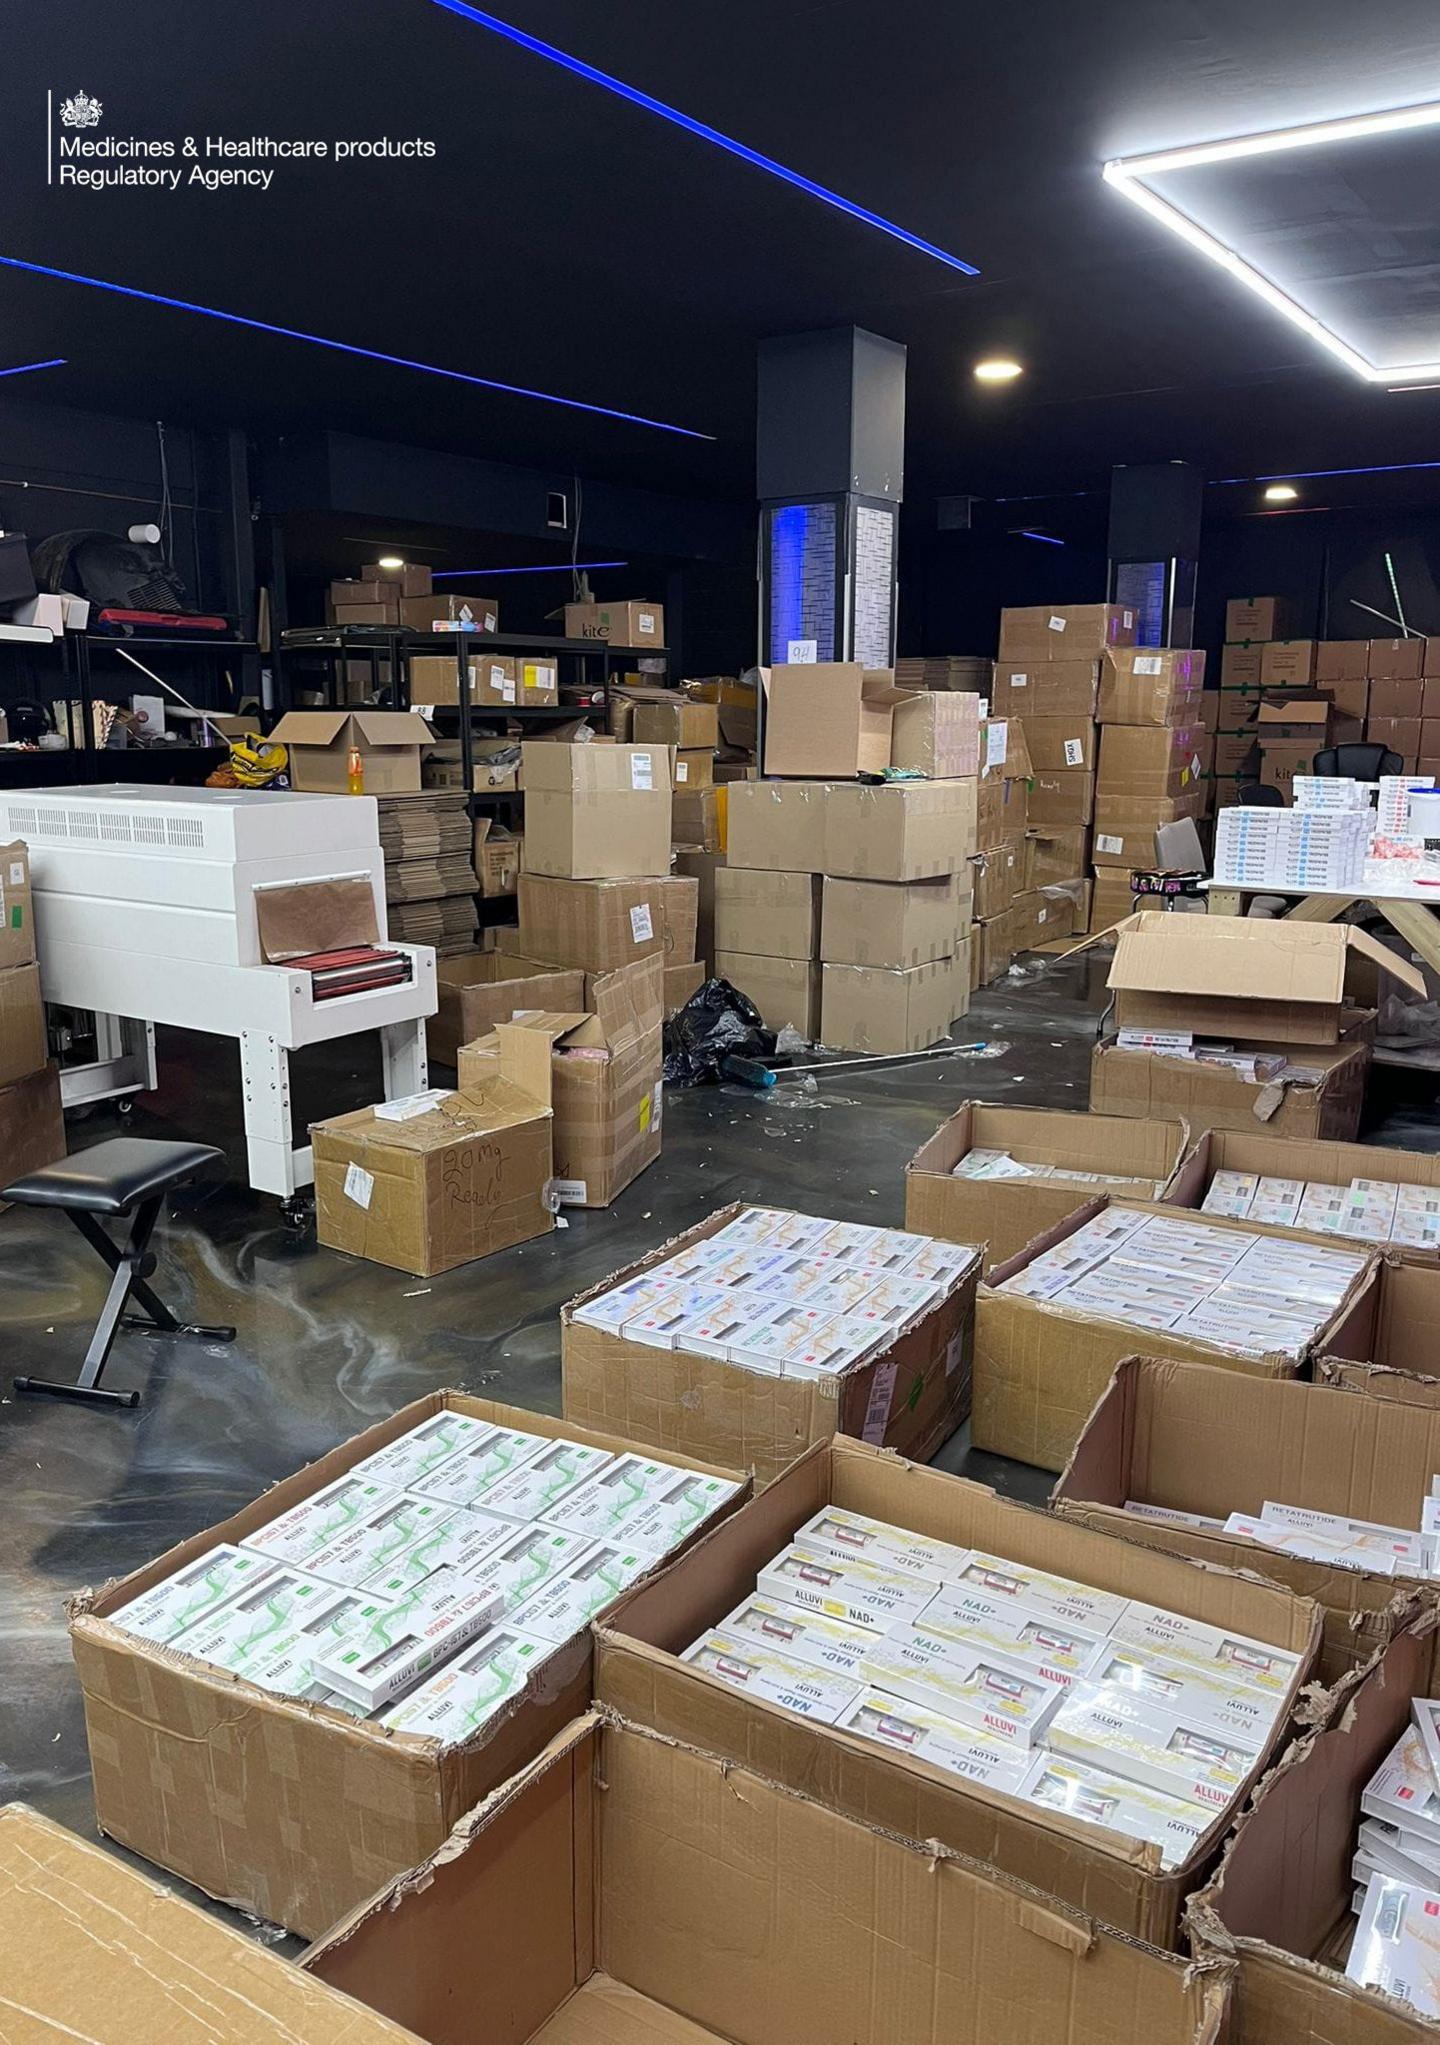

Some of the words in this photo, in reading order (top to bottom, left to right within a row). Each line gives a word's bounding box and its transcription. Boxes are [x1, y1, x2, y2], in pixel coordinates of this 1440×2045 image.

[582, 623, 611, 638] kite
[794, 1589, 823, 1606] ALLUVI
[388, 1663, 416, 1691] ALLUVI
[1038, 1667, 1072, 1686] ALLUVI
[983, 1713, 1018, 1735] ALLUVI
[1194, 1783, 1230, 1803] ALLUV
